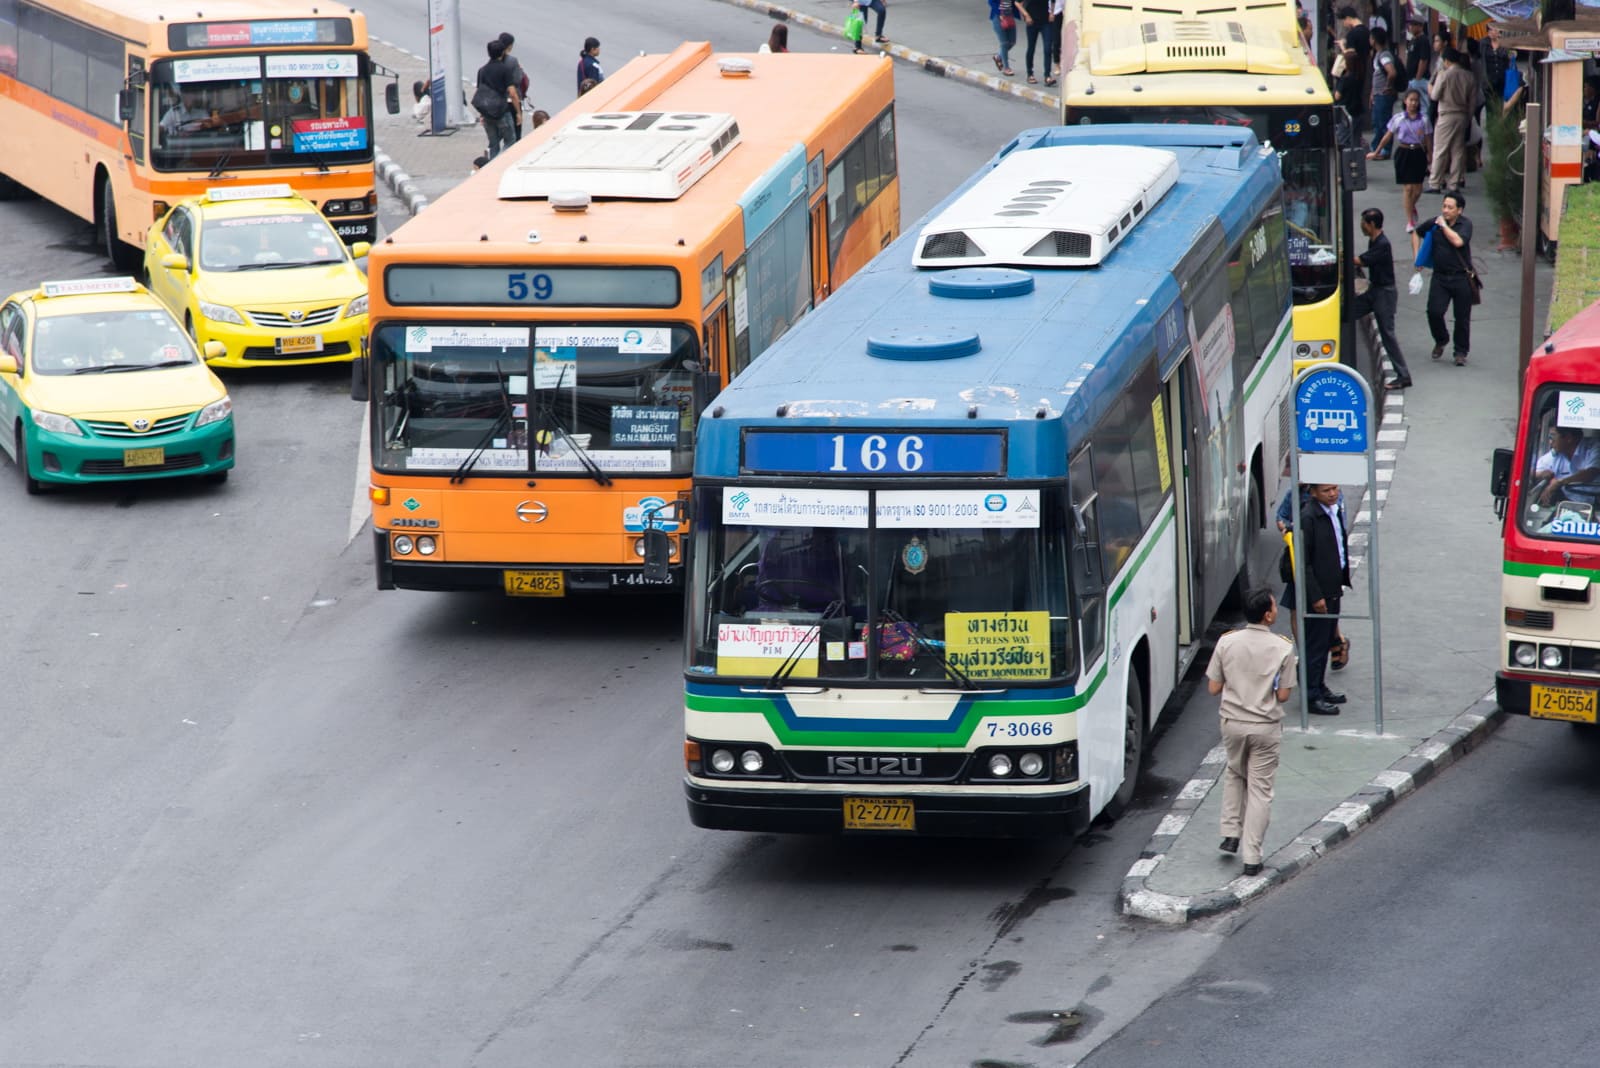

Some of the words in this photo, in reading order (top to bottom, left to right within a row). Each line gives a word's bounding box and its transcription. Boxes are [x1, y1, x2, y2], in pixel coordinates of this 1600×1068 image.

[1285, 123, 1300, 132] 22
[508, 273, 553, 300] 59
[567, 336, 579, 346] ISO
[630, 423, 669, 433] RANGSIT
[615, 433, 677, 442] SANAMLUANG
[829, 434, 924, 471] 166
[913, 504, 925, 516] ISO
[929, 504, 978, 516] 9001:2008
[391, 518, 440, 528] HINO
[510, 576, 560, 590] 12-4825
[967, 612, 1029, 633] ทางด่วน
[967, 636, 1009, 645] EXPRESS
[1012, 635, 1032, 644] WAY
[991, 667, 1049, 678] MONUMENT
[1537, 692, 1592, 713] 12-0554
[987, 721, 1053, 737] 7-3066
[827, 756, 922, 775] ISUZU
[849, 804, 911, 820] 12-2777
